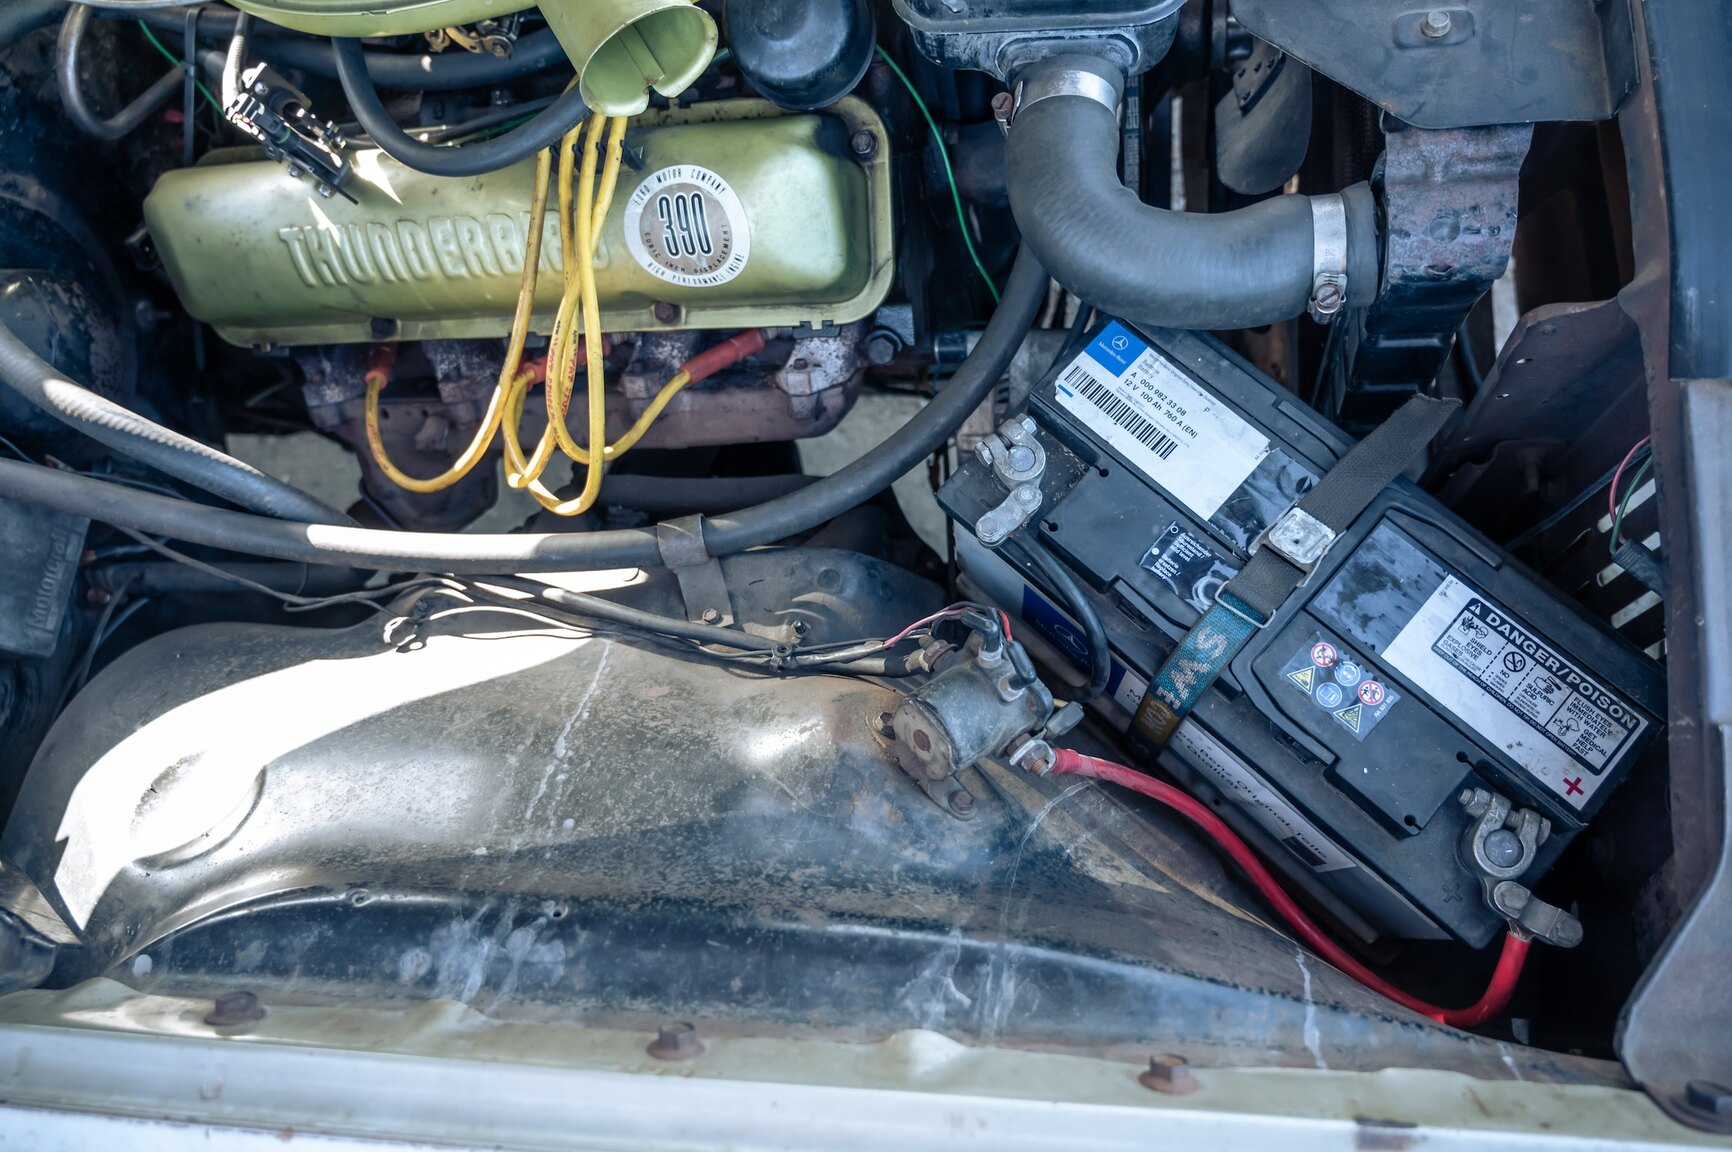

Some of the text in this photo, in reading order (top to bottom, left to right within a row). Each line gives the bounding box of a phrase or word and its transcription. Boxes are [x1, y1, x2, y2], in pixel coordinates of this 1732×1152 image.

[633, 168, 726, 205] FORD MOTOR COMPANY
[657, 192, 713, 258] 390
[644, 224, 730, 274] CUBIC INCH DISPLACEMENT
[648, 253, 745, 285] HIGH PERFORMANCE ENGINE
[1123, 378, 1132, 386] 12
[1139, 391, 1153, 402] 100
[1151, 400, 1163, 410] Ah
[1163, 409, 1177, 422] 760
[1181, 424, 1198, 438] (EN)
[1139, 378, 1154, 391] 000
[1152, 389, 1167, 401] 982
[1165, 399, 1177, 408] 33
[1175, 406, 1187, 416] 08
[1442, 639, 1463, 656] GASES
[1443, 654, 1453, 662] OUT
[1445, 634, 1479, 661] EXPLOSIVE
[1465, 641, 1483, 656] EYES
[1469, 637, 1493, 656] SHIELD
[1485, 612, 1638, 729] DANGER/POISON
[1499, 669, 1510, 678] NO
[1521, 687, 1537, 700] ACID
[1525, 682, 1555, 706] SULFURIC
[1565, 705, 1606, 738] WITH WATER
[1569, 701, 1613, 735] IMMEDIATELY
[1573, 696, 1613, 728] FLUSH EYES
[1575, 737, 1594, 753] HELP
[1578, 733, 1608, 757] MEDICAL
[1582, 728, 1596, 741] GET
[1571, 742, 1589, 757] FAST
